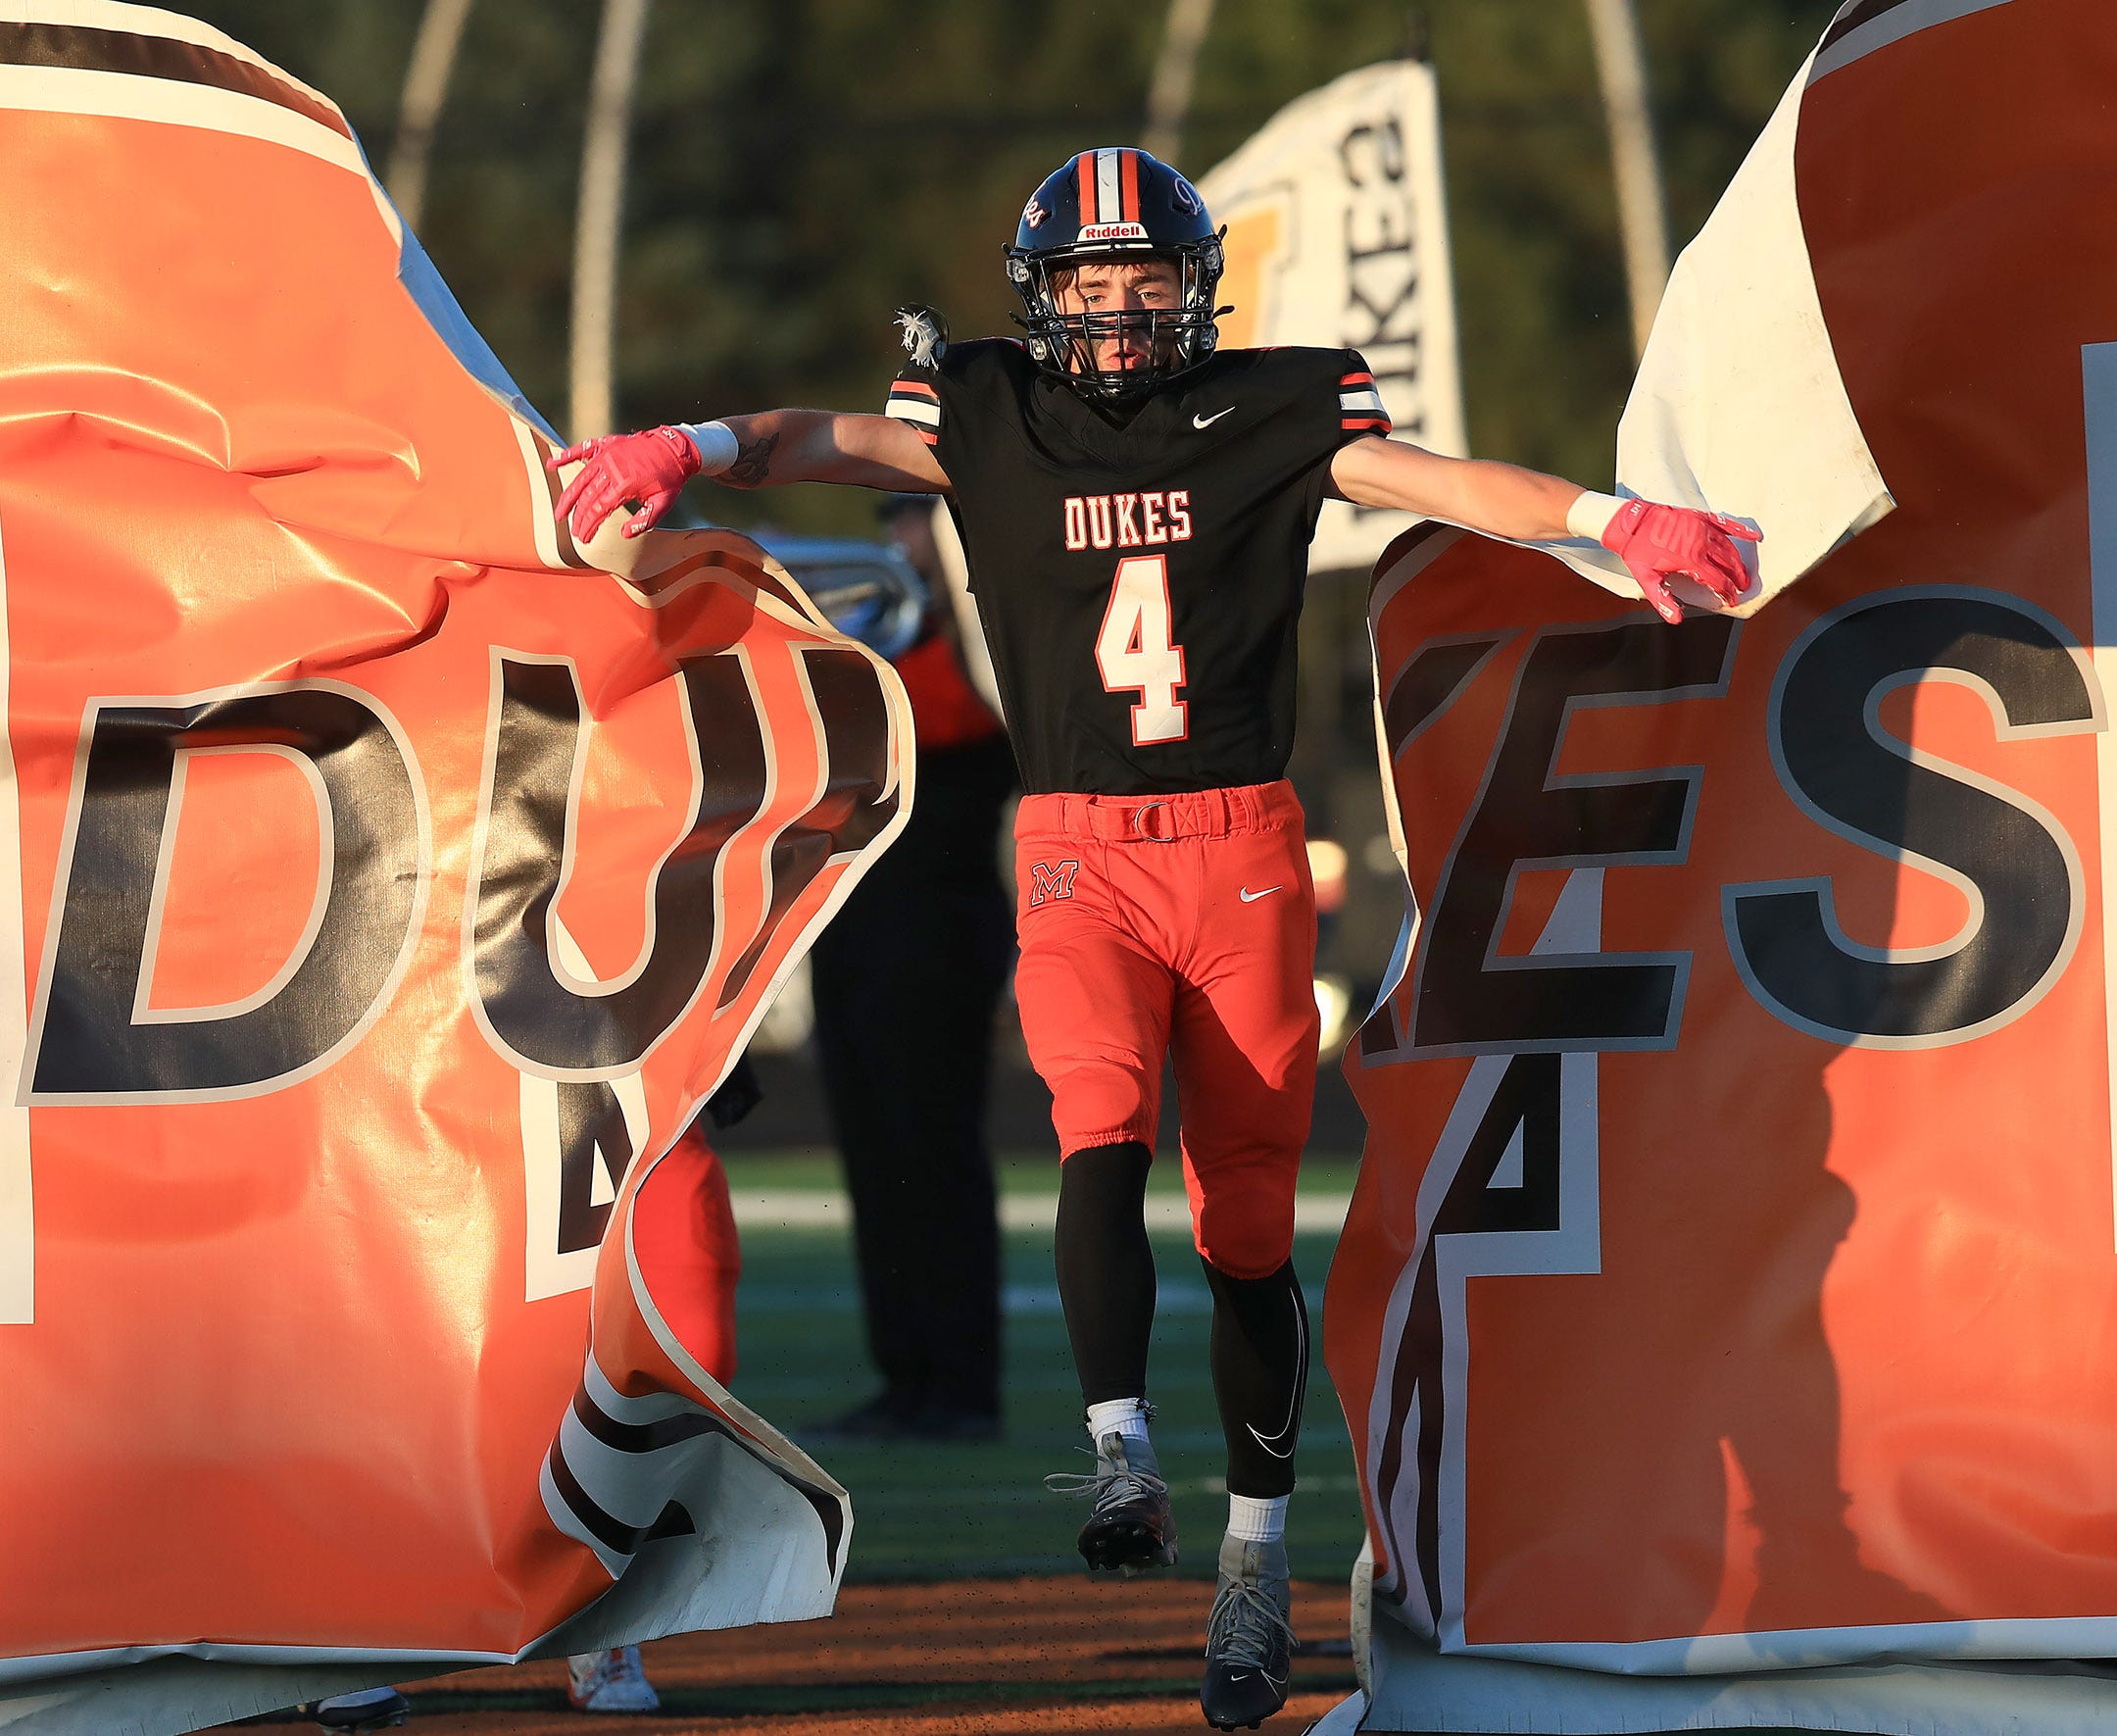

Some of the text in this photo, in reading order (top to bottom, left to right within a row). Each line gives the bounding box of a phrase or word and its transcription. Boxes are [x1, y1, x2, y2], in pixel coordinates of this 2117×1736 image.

[1085, 225, 1141, 239] Riddell
[1064, 490, 1193, 551] DUKES
[1094, 554, 1190, 747] 4
[1031, 858, 1079, 908] M
